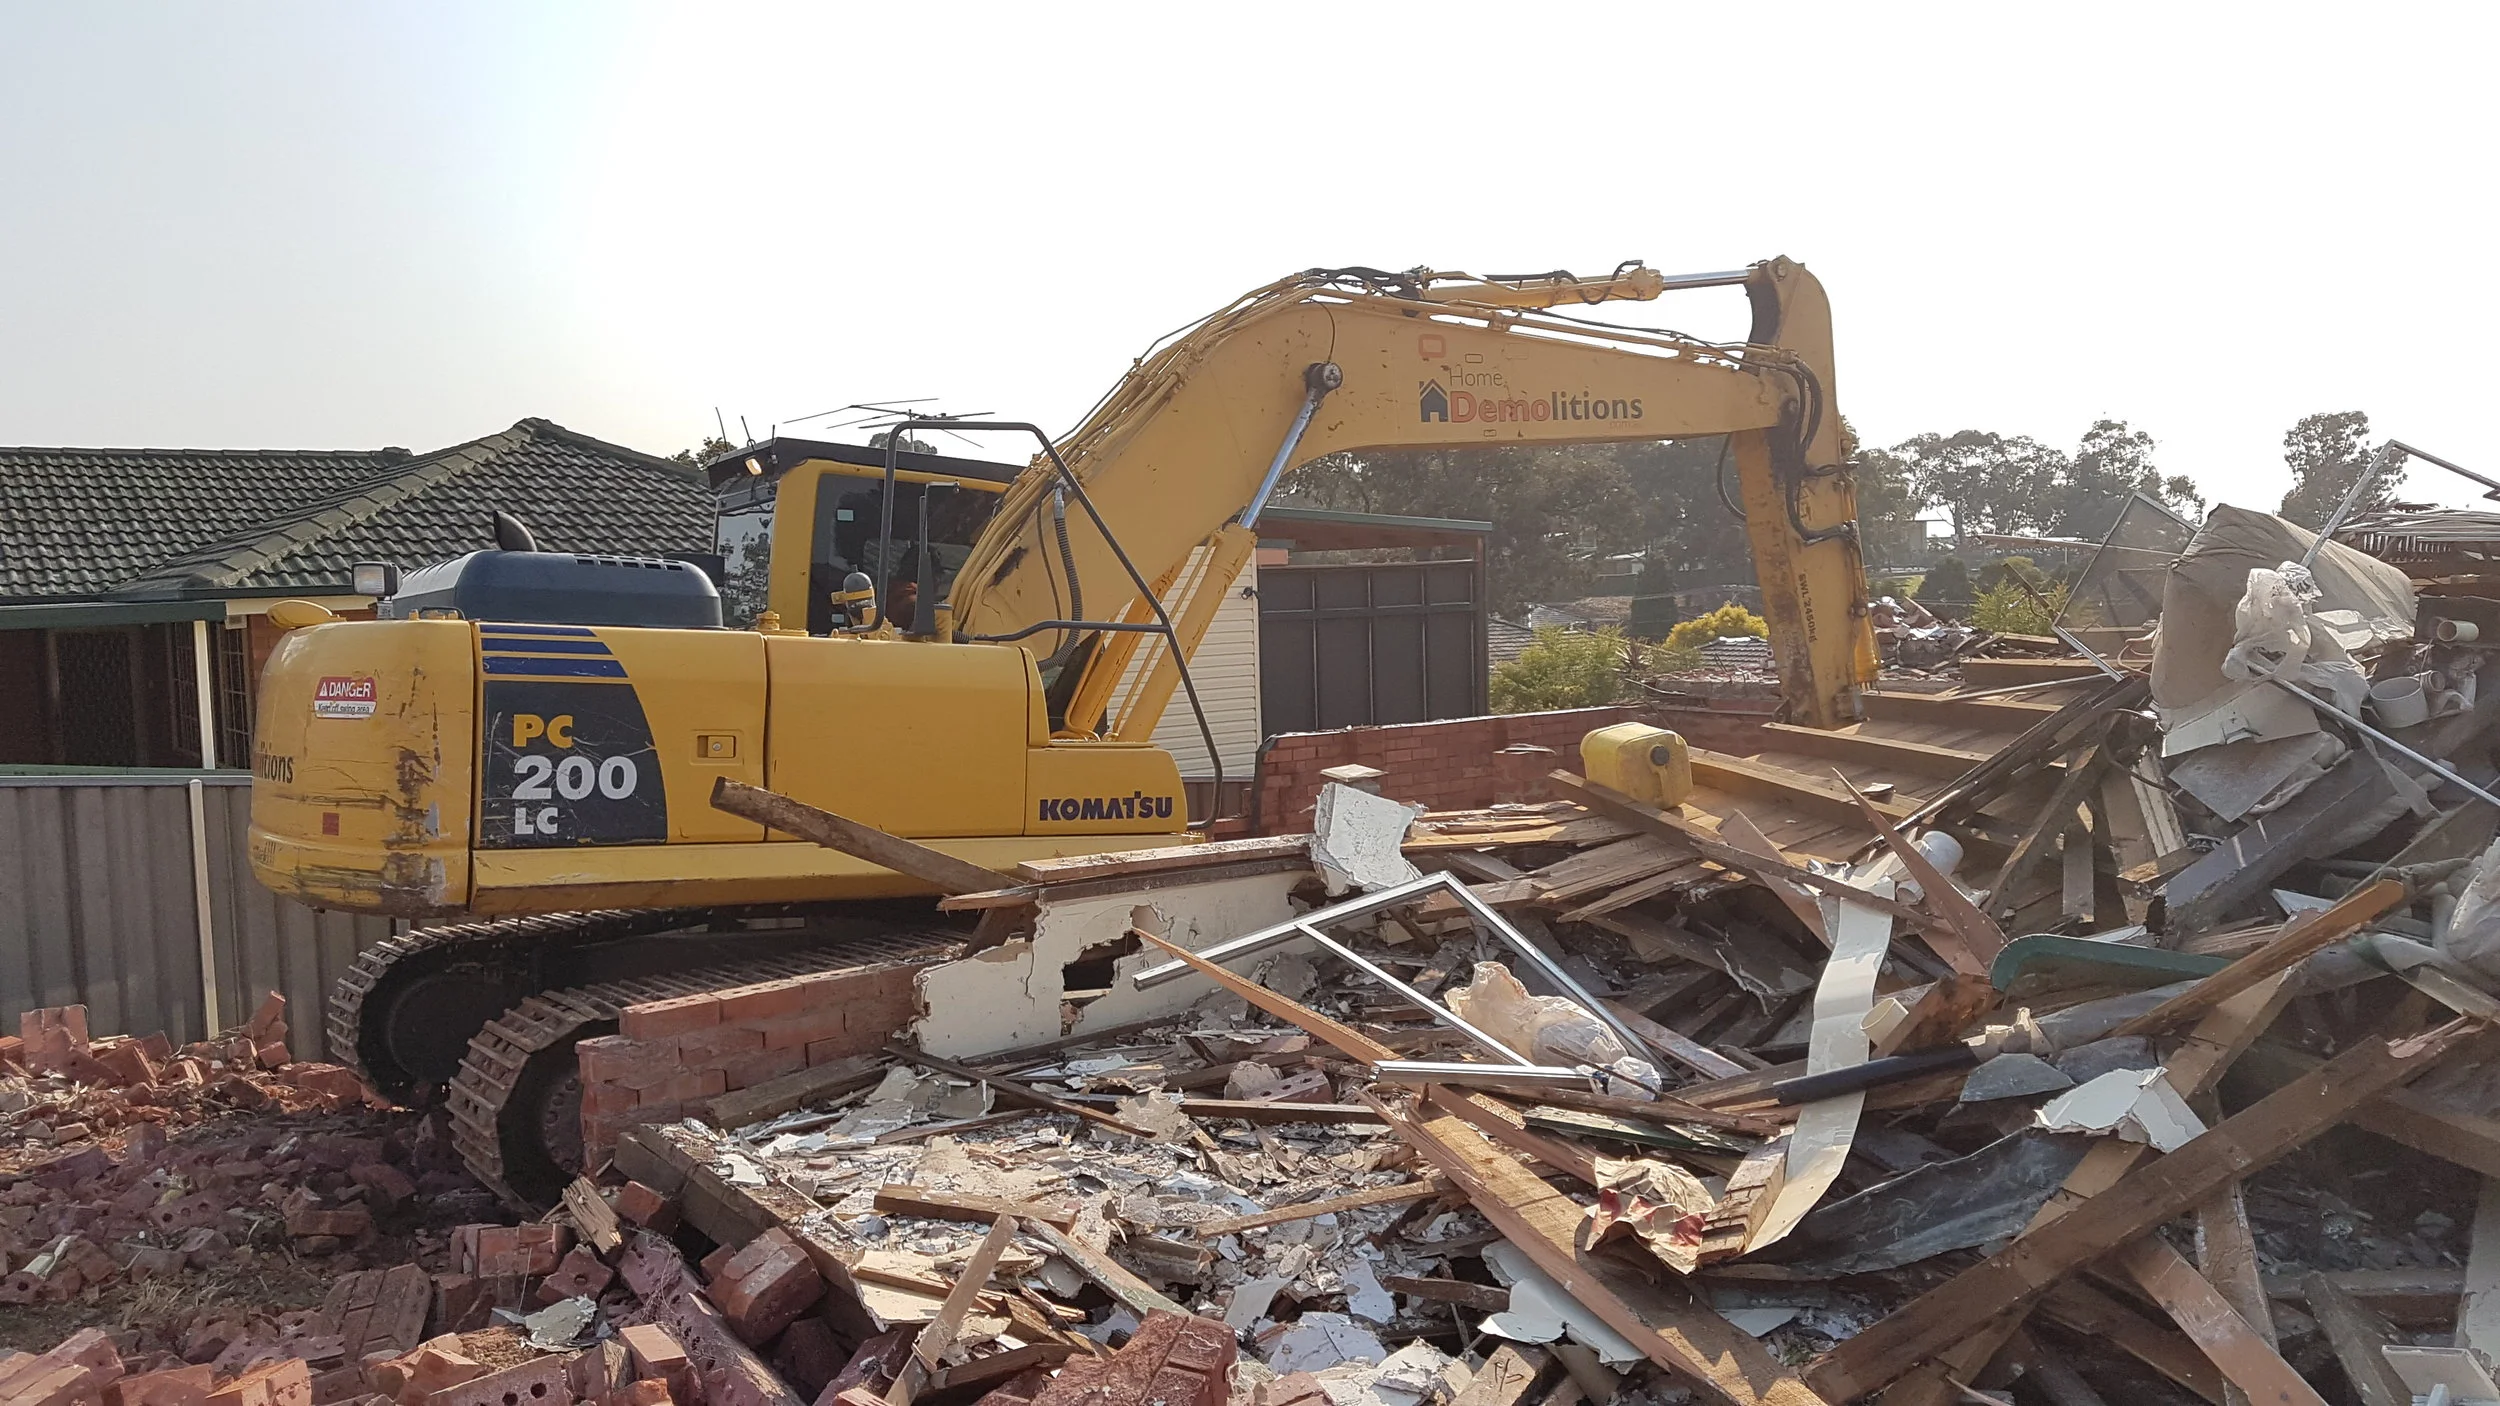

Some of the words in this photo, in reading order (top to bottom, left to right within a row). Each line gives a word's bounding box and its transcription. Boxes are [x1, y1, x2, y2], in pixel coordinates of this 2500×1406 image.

[1450, 366, 1504, 387] Home
[1450, 390, 1643, 423] Demolitions
[1799, 573, 1809, 598] SWL
[328, 681, 371, 697] DANGER
[513, 714, 574, 748] PC
[511, 754, 638, 800] 200
[1039, 791, 1173, 821] KOMATSU
[514, 807, 559, 835] LC
